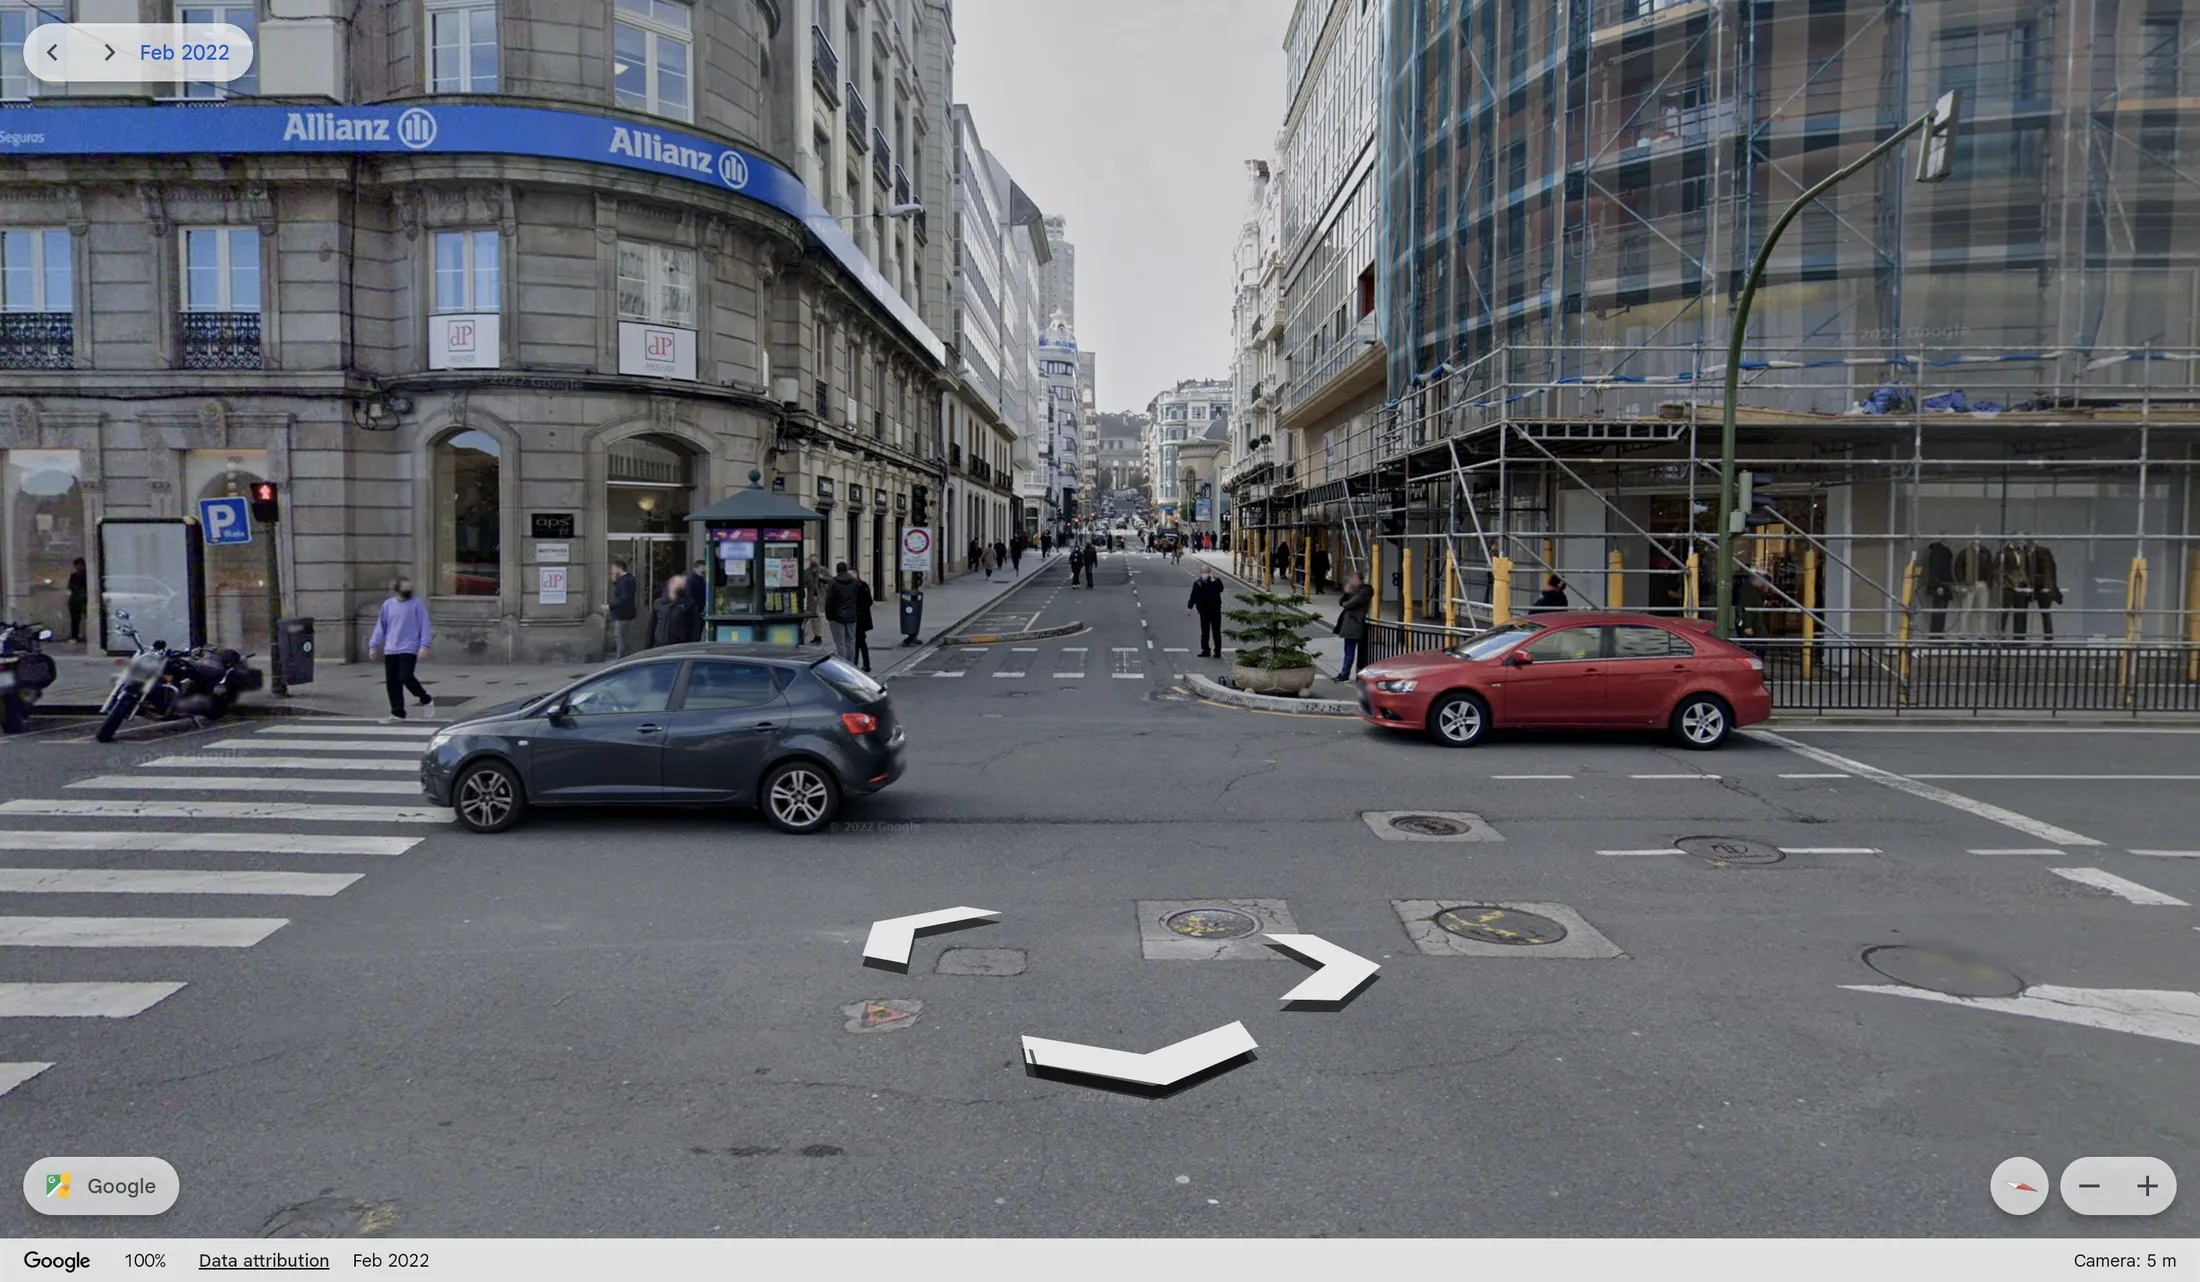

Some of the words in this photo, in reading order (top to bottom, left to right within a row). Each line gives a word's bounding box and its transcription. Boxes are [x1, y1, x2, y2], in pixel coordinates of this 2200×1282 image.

[283, 112, 390, 142] Allianz
[609, 126, 713, 174] Allianz
[207, 504, 236, 539] P
